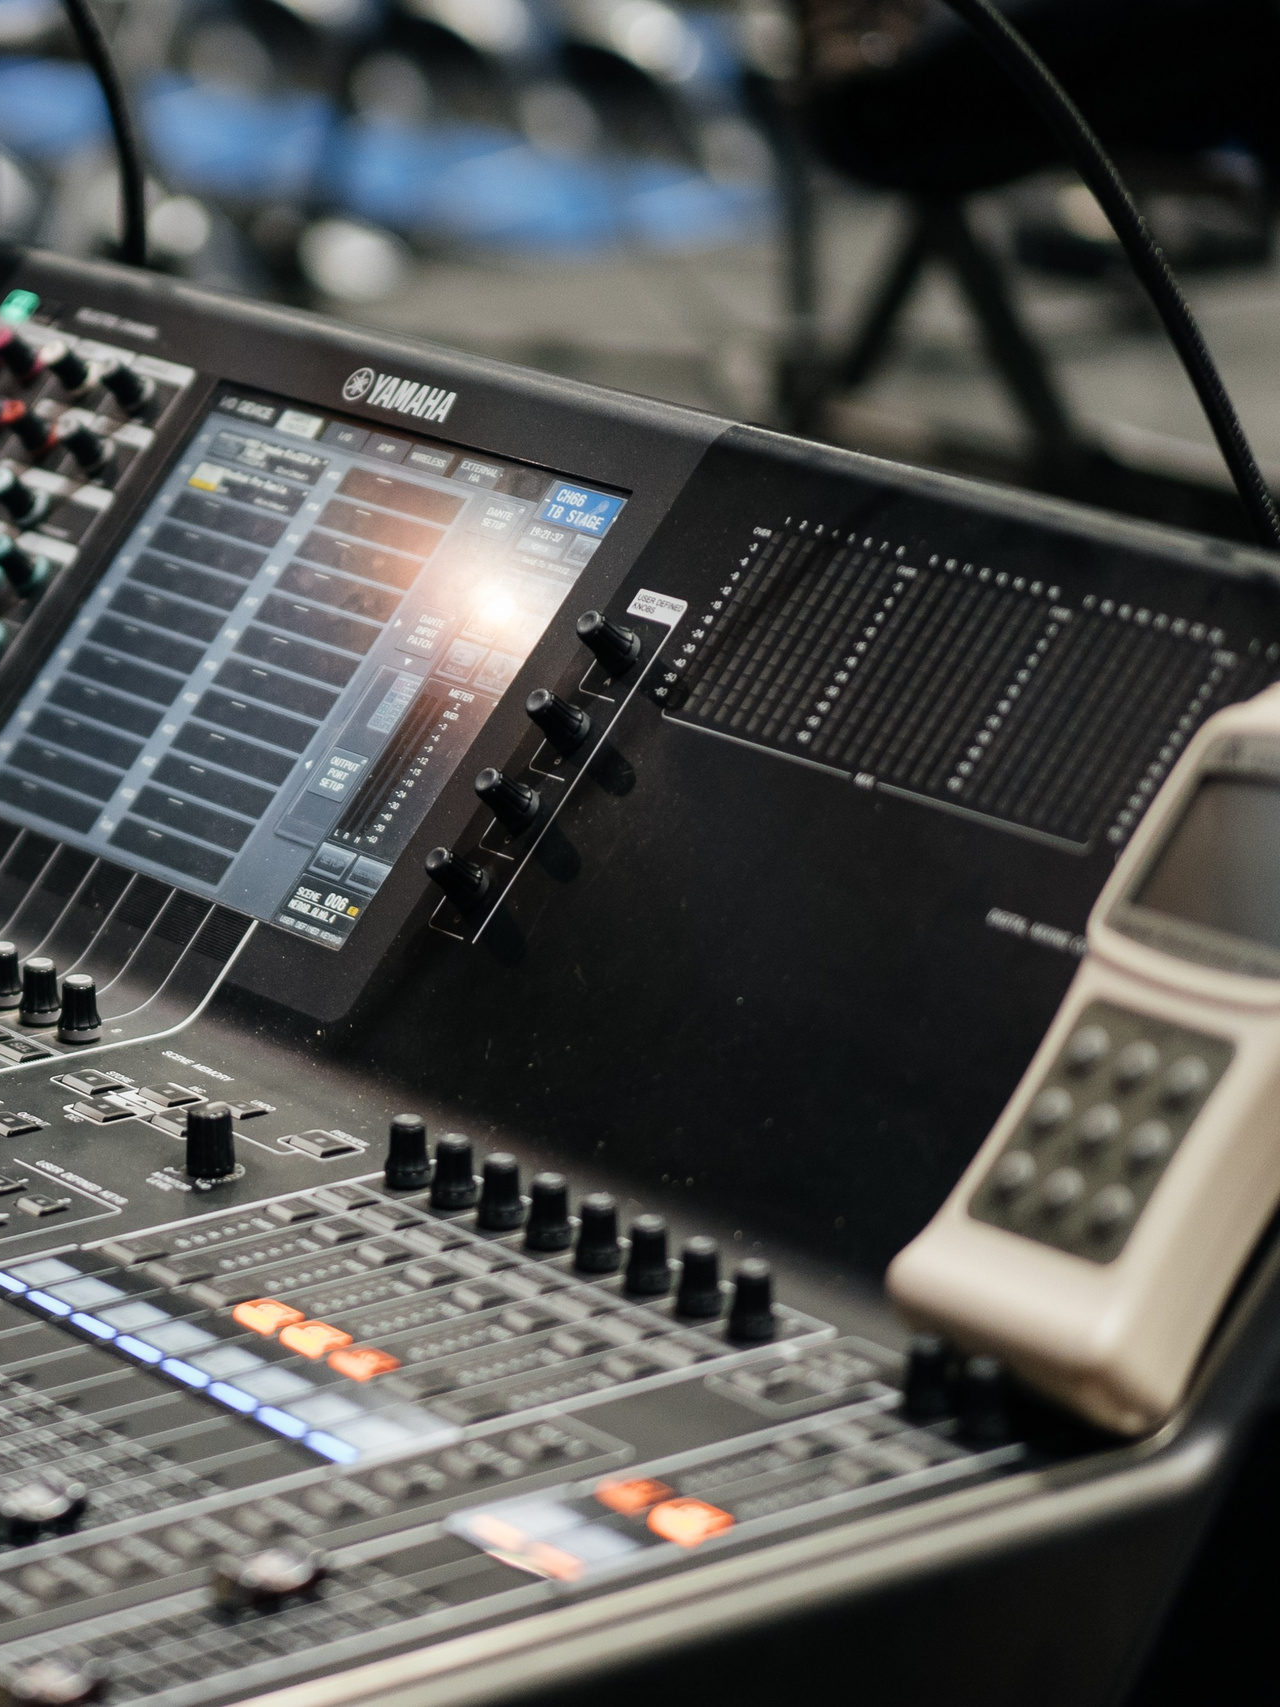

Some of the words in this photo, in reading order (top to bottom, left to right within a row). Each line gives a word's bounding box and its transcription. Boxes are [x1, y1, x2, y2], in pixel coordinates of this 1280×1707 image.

[366, 373, 457, 423] YAMAHA
[410, 451, 447, 468] WIRELESS
[459, 460, 499, 478] EXTERNAL
[468, 473, 480, 483] HA
[556, 489, 588, 508] CH66
[486, 507, 514, 521] DANTE
[546, 504, 564, 519] TB
[565, 510, 605, 531] STAGE
[481, 518, 507, 531] SETUP
[529, 526, 564, 543] 19:21:37
[753, 526, 772, 538] OVER
[632, 602, 656, 614] KNOBS
[637, 594, 657, 606] USER
[655, 599, 685, 613] DEFINED
[419, 614, 447, 629] DANTE
[415, 625, 439, 639] INPUT
[406, 635, 434, 650] PATCH
[448, 688, 475, 703] METER
[443, 710, 459, 721] OVER
[438, 723, 448, 731] -3
[431, 734, 440, 742] -6
[330, 756, 361, 772] OUTPUT
[416, 757, 429, 766] -12
[327, 768, 349, 780] PORT
[409, 768, 422, 776] -15
[319, 777, 344, 791] SETUP
[402, 779, 415, 787] -18
[395, 790, 407, 798] -24
[388, 801, 400, 810] -30
[381, 813, 393, 821] -40
[373, 824, 386, 832] -50
[366, 835, 378, 843] -60
[296, 886, 322, 902] SCENE
[324, 893, 349, 911] 006
[279, 914, 295, 925] USER
[295, 919, 320, 936] DEFINED
[161, 1050, 195, 1066] SCENE
[191, 1063, 235, 1082] MEMORY
[105, 1070, 136, 1084] STORE
[17, 1112, 52, 1127] OUTPUT
[35, 1160, 65, 1174] USER
[60, 1171, 103, 1193] DEFINED
